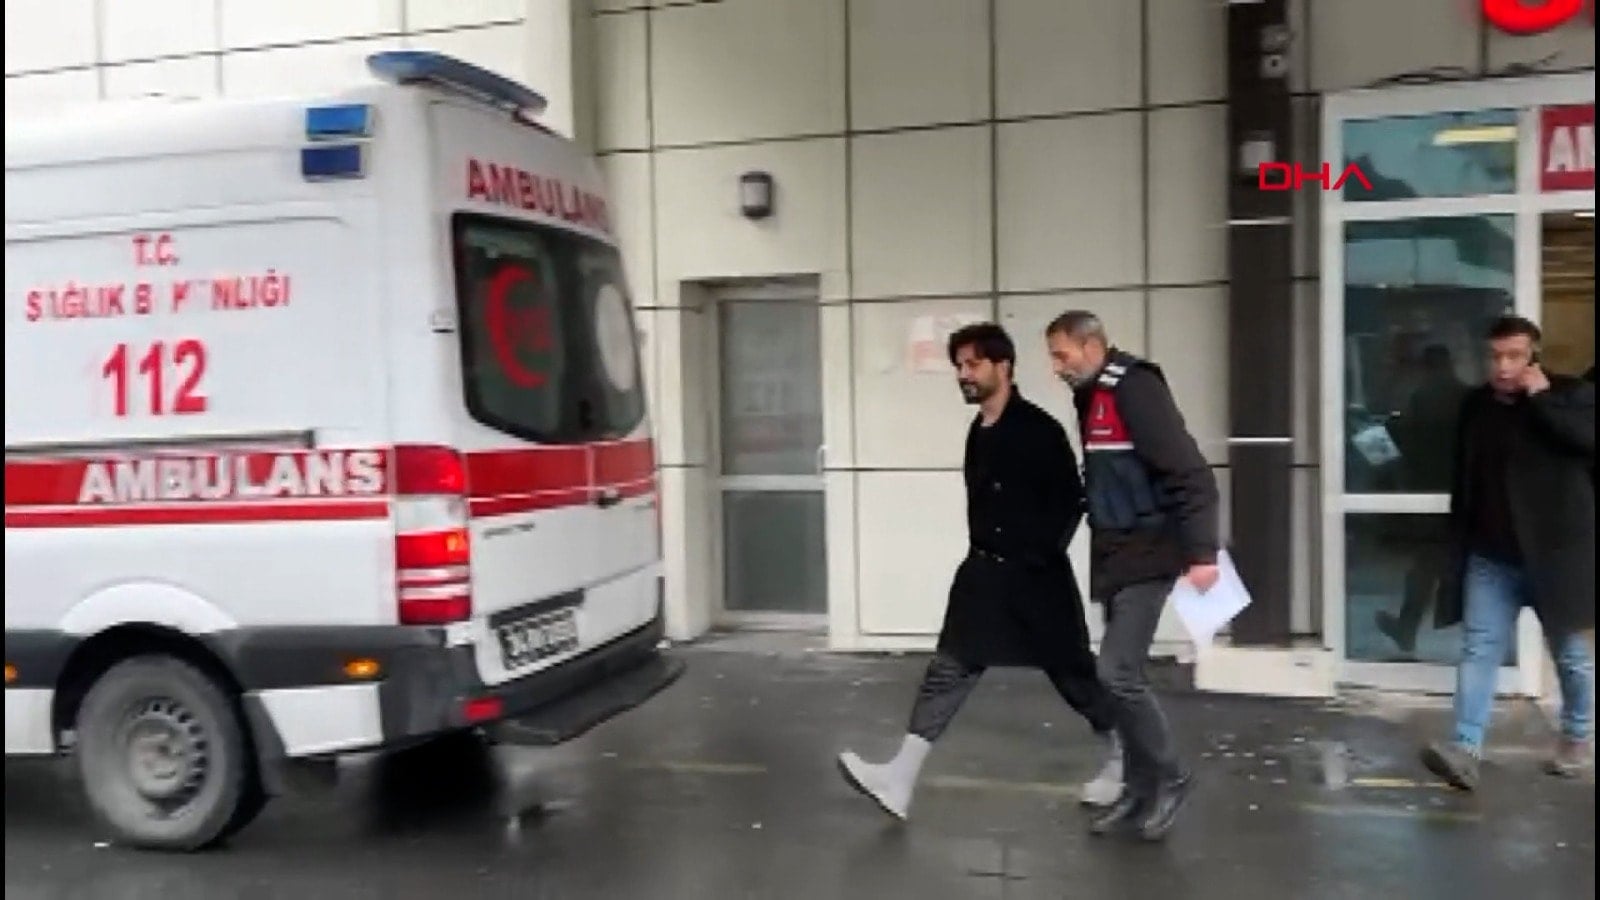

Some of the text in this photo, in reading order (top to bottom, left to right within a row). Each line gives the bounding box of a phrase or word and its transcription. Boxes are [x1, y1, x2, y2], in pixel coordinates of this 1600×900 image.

[134, 268, 292, 317] BKNLIĞI
[102, 338, 210, 417] 112
[79, 449, 387, 504] AMBULANS
